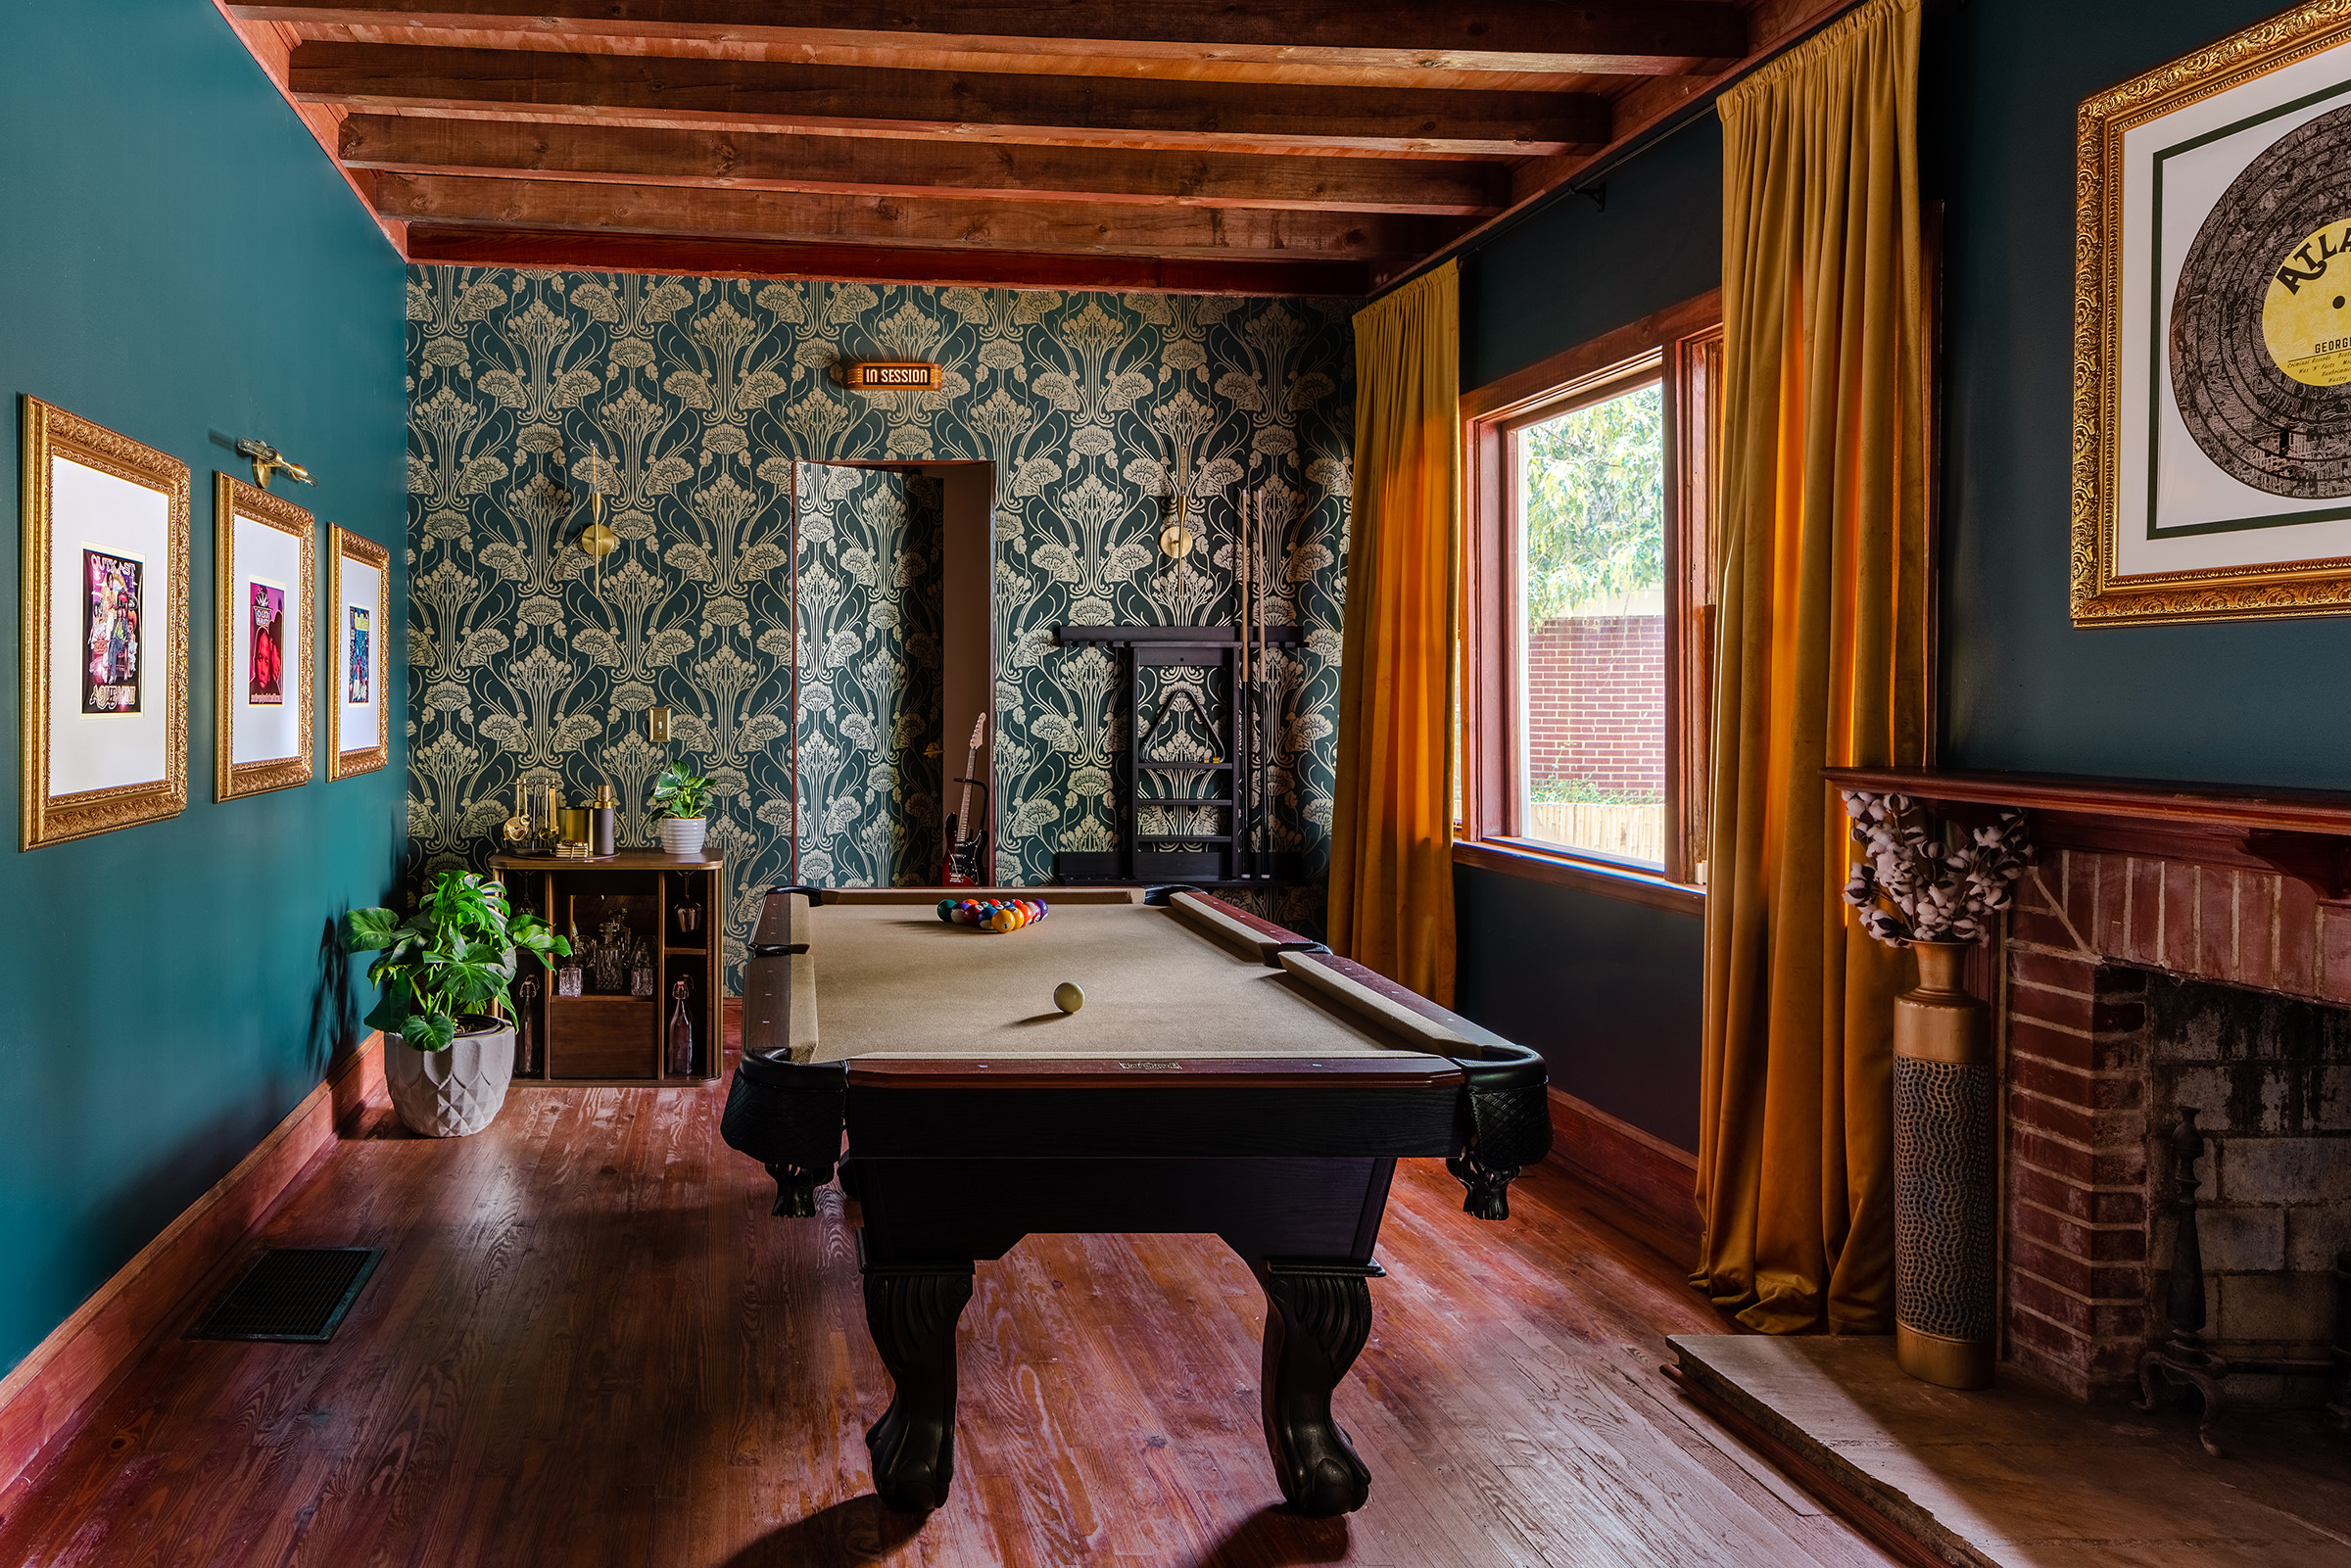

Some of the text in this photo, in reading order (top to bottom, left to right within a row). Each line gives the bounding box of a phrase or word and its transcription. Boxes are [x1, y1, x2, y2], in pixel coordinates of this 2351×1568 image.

[866, 368, 928, 383] IN SESSION
[90, 553, 136, 577] OUTKAST
